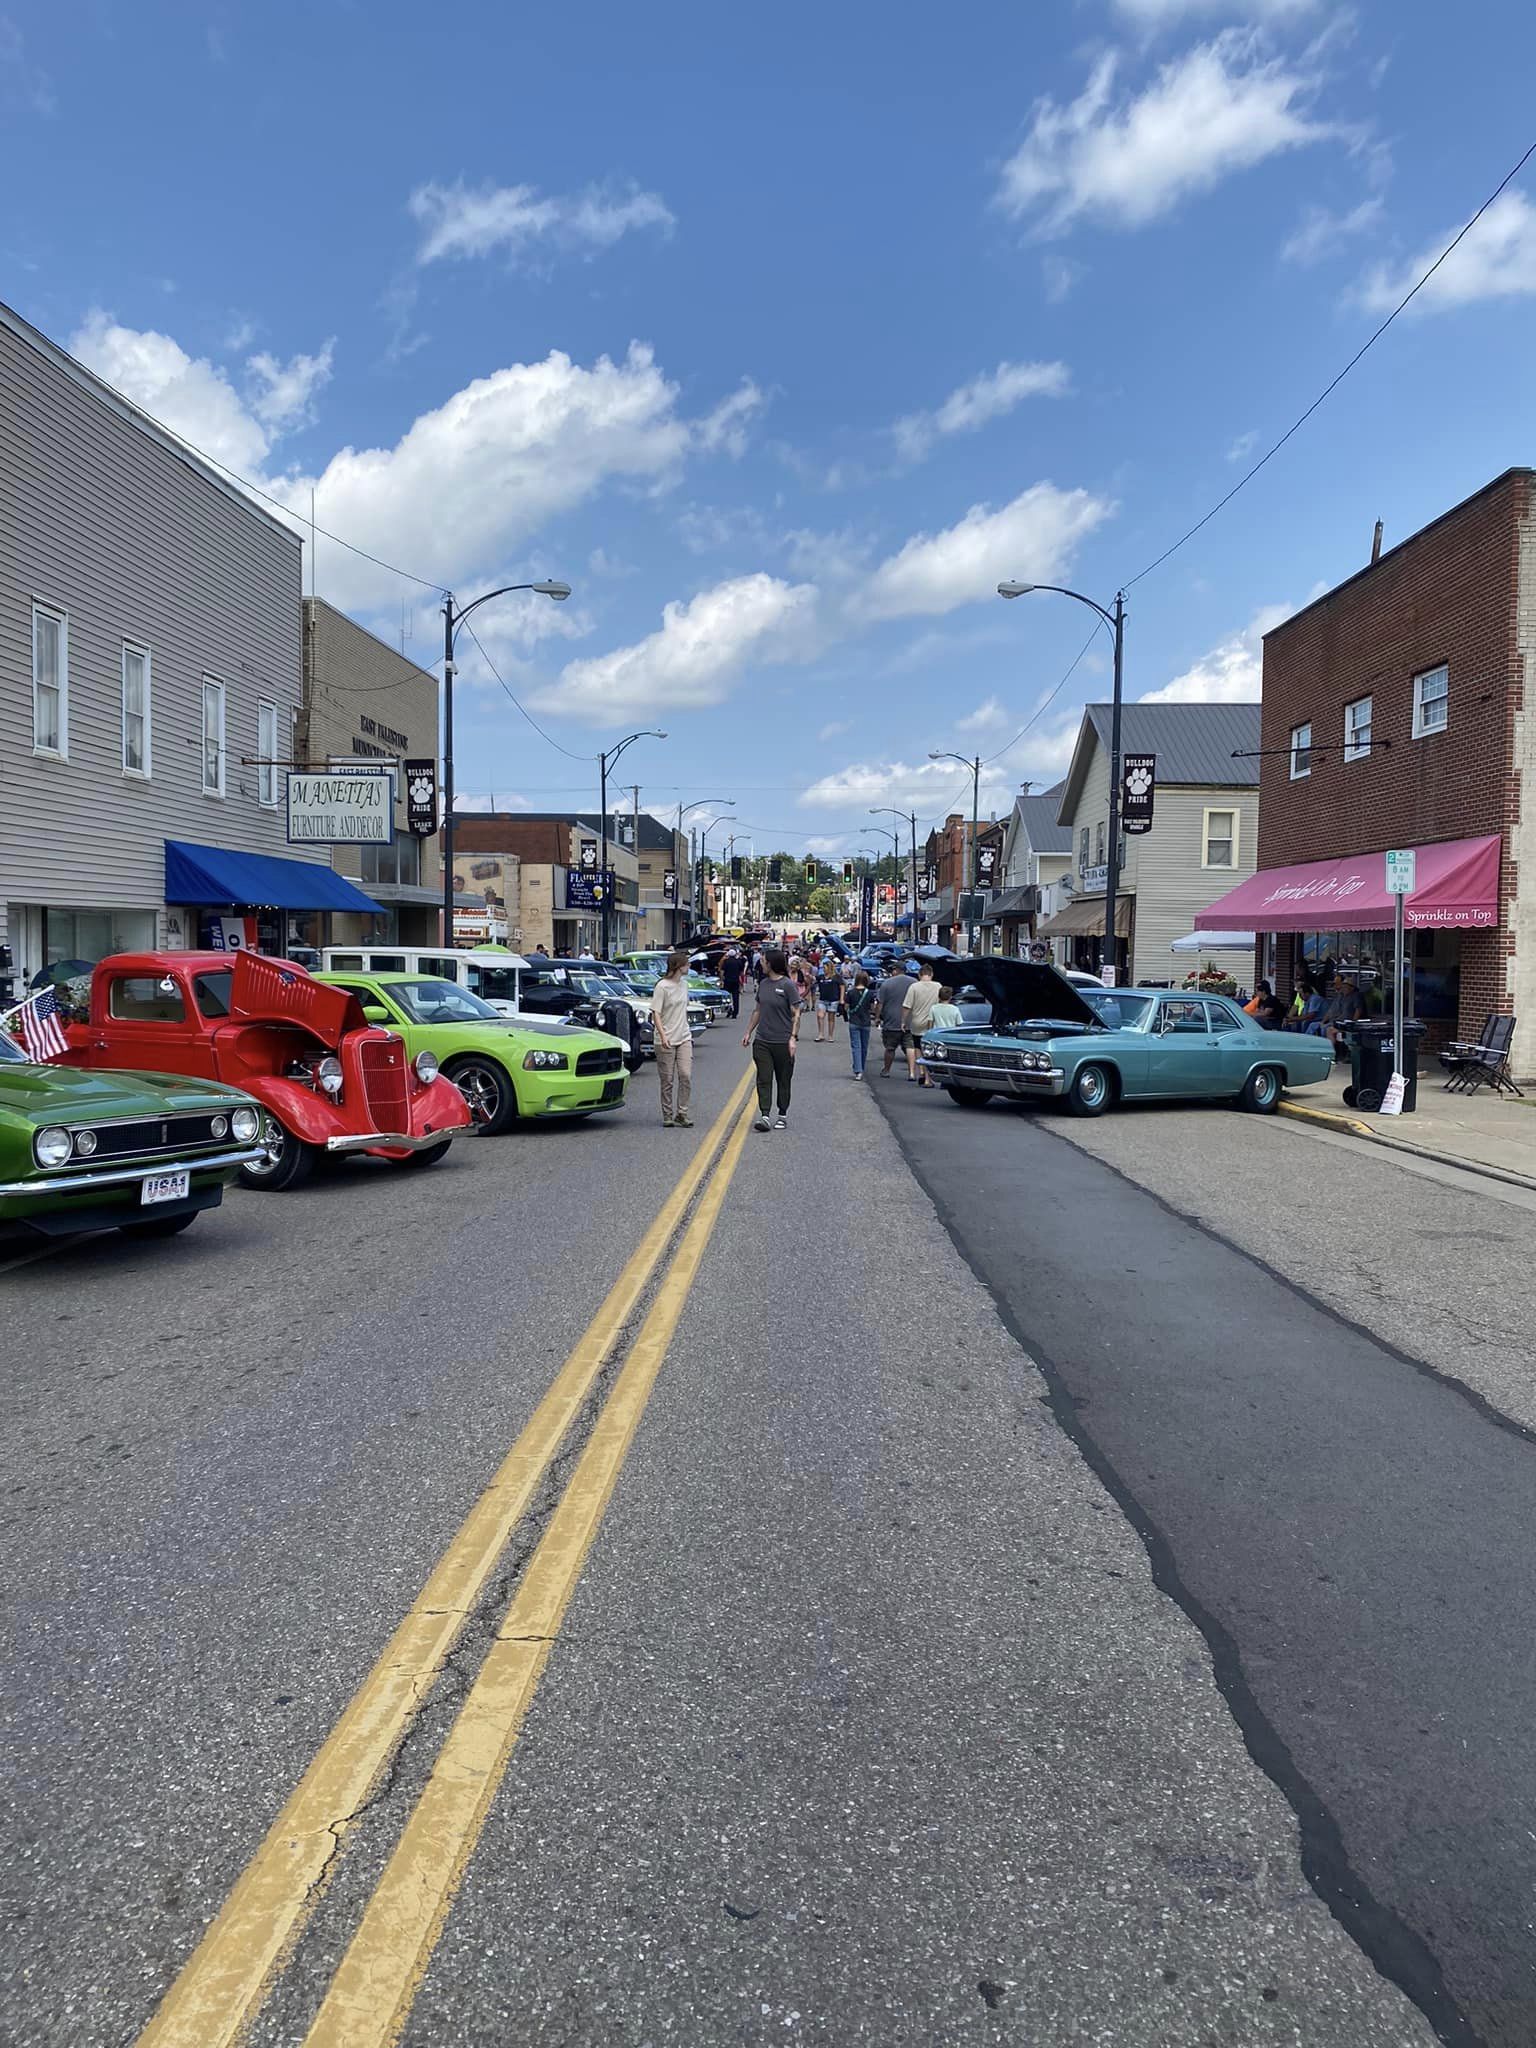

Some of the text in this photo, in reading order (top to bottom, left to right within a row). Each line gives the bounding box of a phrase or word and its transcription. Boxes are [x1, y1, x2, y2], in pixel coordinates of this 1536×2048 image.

[361, 714, 376, 736] EAST
[1126, 759, 1154, 767] BULLDOG
[407, 768, 433, 777] BULLDOG
[1128, 795, 1148, 804] PRIDE
[412, 804, 431, 812] PRIDE
[292, 814, 384, 839] FURNITURE AND DECOR
[1407, 908, 1492, 924] Sprinklz on Top
